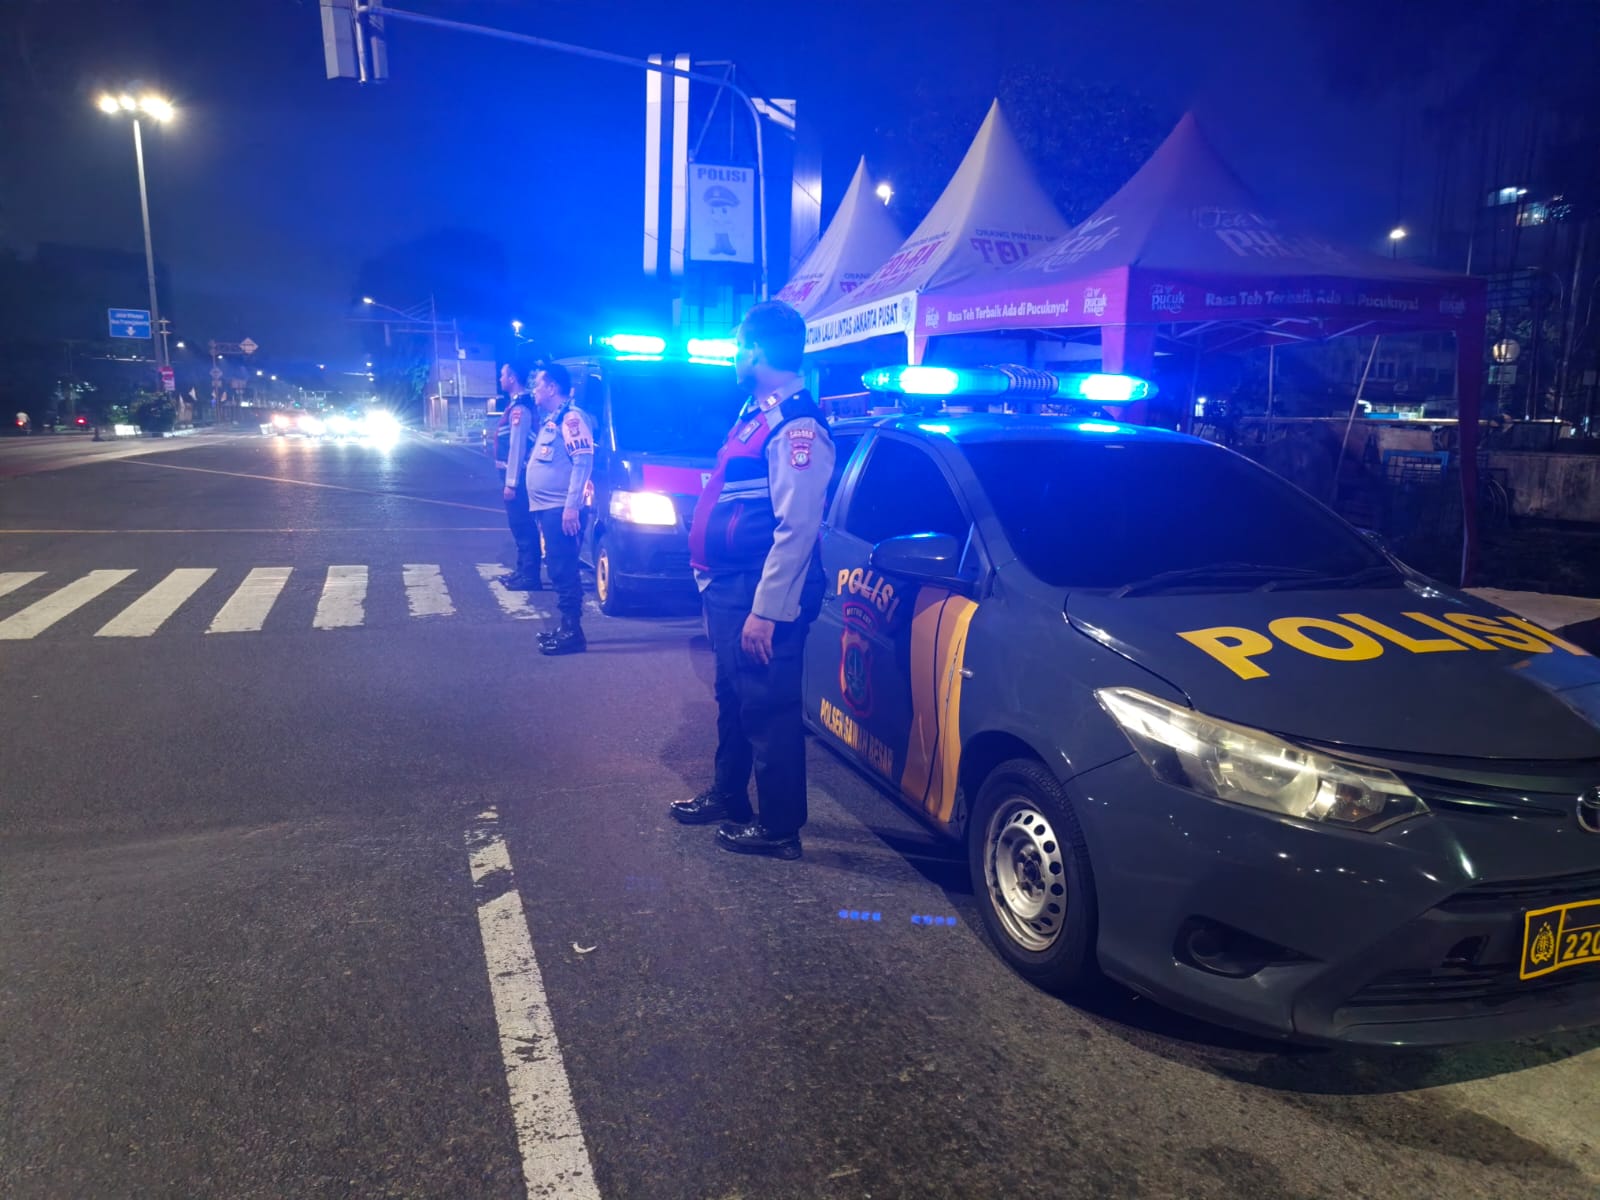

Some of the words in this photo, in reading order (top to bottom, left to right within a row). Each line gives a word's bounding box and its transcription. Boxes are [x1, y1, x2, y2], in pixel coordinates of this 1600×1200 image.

[697, 167, 746, 183] POLISI
[963, 308, 974, 321] Teh
[976, 306, 1001, 320] Terbaik
[1002, 304, 1017, 317] Ada
[1017, 303, 1026, 316] di
[1026, 299, 1069, 317] Pucuknya!
[1205, 292, 1237, 306] Rasa
[1239, 290, 1262, 305] Teh
[879, 302, 898, 328] PUSAT
[837, 567, 899, 623] POLISI
[1176, 612, 1593, 680] POLISI
